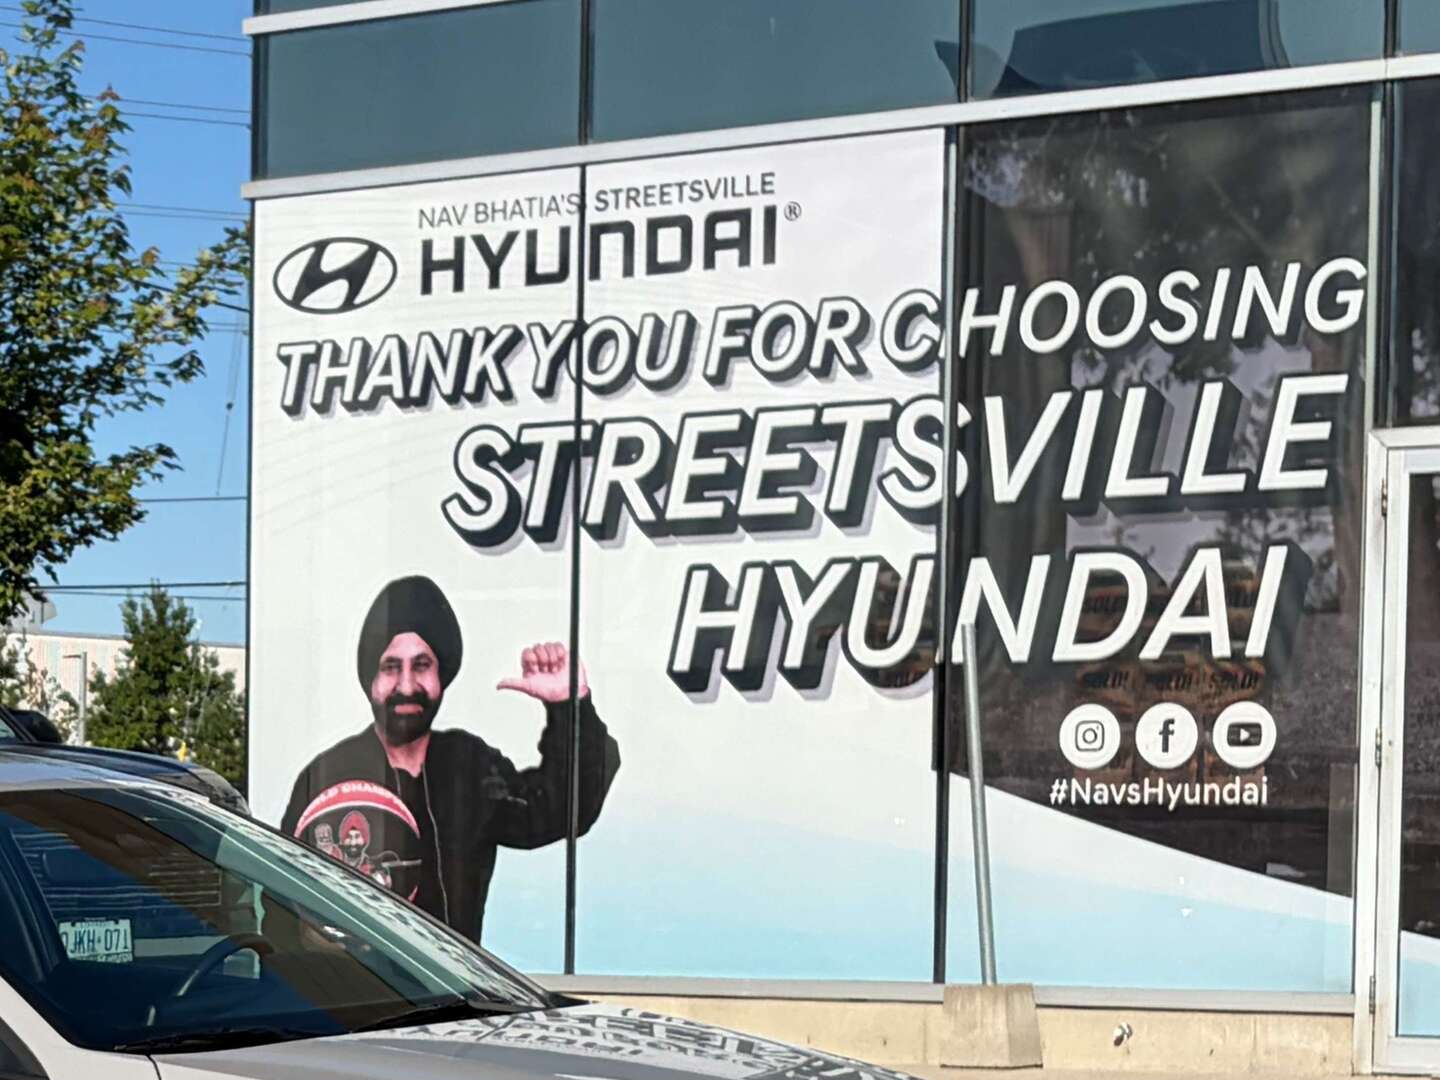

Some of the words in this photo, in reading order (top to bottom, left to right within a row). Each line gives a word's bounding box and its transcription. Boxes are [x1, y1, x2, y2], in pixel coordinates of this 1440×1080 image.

[418, 203, 468, 230] NAV
[474, 192, 581, 224] BHATIA'S
[594, 172, 776, 213] STREETSVILLE
[276, 325, 523, 418] THANK
[527, 310, 698, 400] YOU
[703, 297, 875, 387] FOR
[880, 257, 1367, 374] CHOOSING
[441, 373, 1350, 552] STREETSVILLE
[667, 544, 1294, 697] HYUNDAI
[1049, 774, 1268, 811] #NavsHyundai
